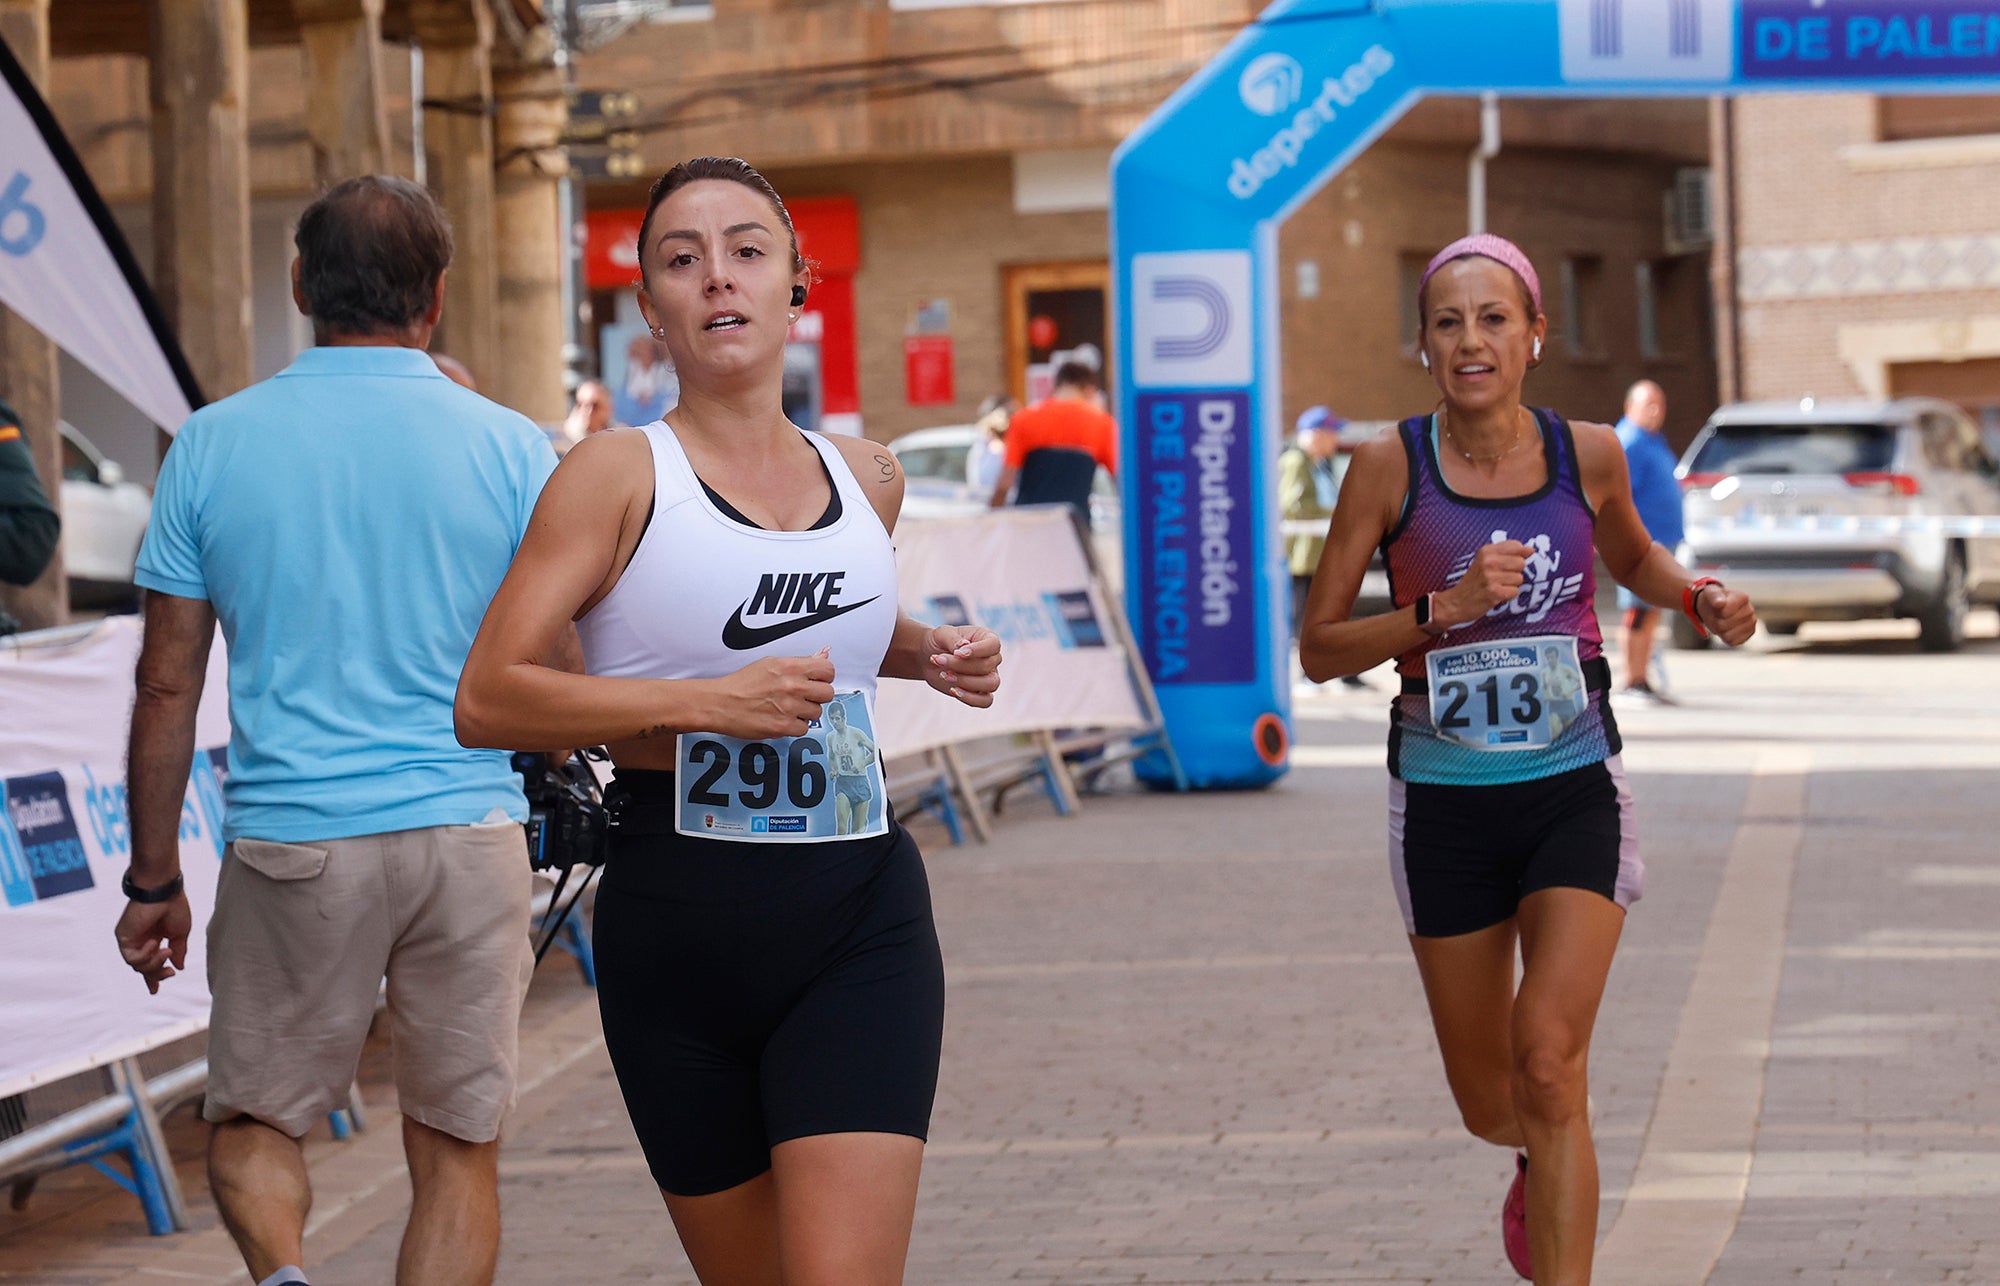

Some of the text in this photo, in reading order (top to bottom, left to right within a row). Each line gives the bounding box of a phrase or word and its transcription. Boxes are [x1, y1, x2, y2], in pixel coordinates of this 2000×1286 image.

[1755, 17, 1830, 60] DE
[1227, 44, 1395, 199] deportes
[1150, 401, 1188, 681] DE PALENCIA
[1191, 400, 1240, 627] Diputación
[746, 571, 846, 616] NIKE
[1439, 673, 1542, 728] 213
[687, 737, 827, 809] 296
[769, 818, 800, 826] Diputación
